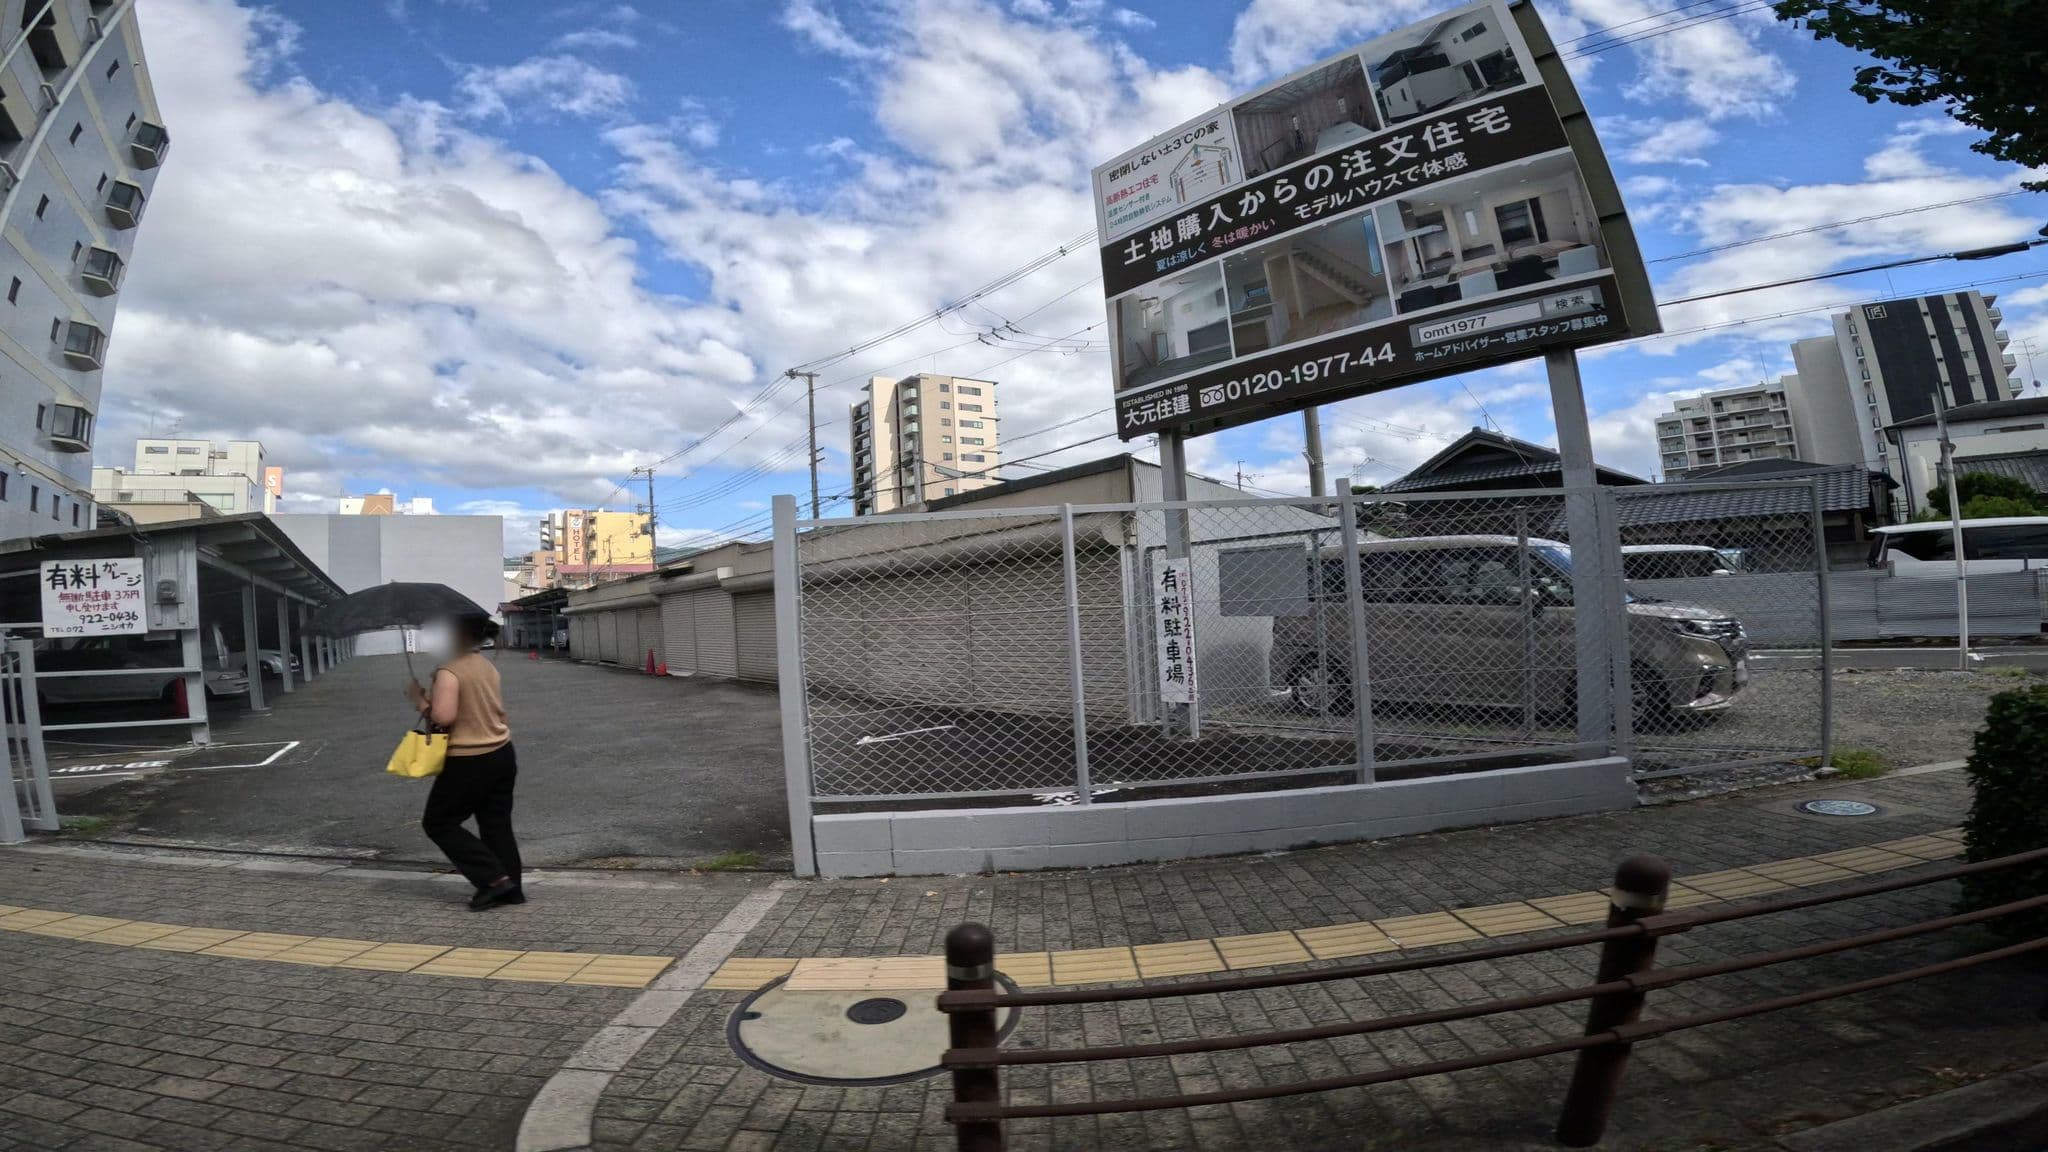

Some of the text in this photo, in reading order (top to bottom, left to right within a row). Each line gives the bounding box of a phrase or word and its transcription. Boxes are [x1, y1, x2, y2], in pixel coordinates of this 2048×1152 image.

[1124, 105, 1512, 265] 土地購入からの注文住宅
[1294, 152, 1468, 219] モデルハウスで体感
[1155, 218, 1276, 272] 夏は涼しく 冬は暖かい
[1555, 295, 1585, 310] 検索
[1423, 316, 1488, 340] omt1977
[1227, 342, 1396, 399] 0120-1977-44
[1124, 394, 1191, 429] 大元住建
[573, 529, 581, 560] HOTEL
[66, 602, 120, 613] 申し受けます
[80, 611, 139, 625] 922-0436
[1161, 566, 1184, 685] 有料駐車場
